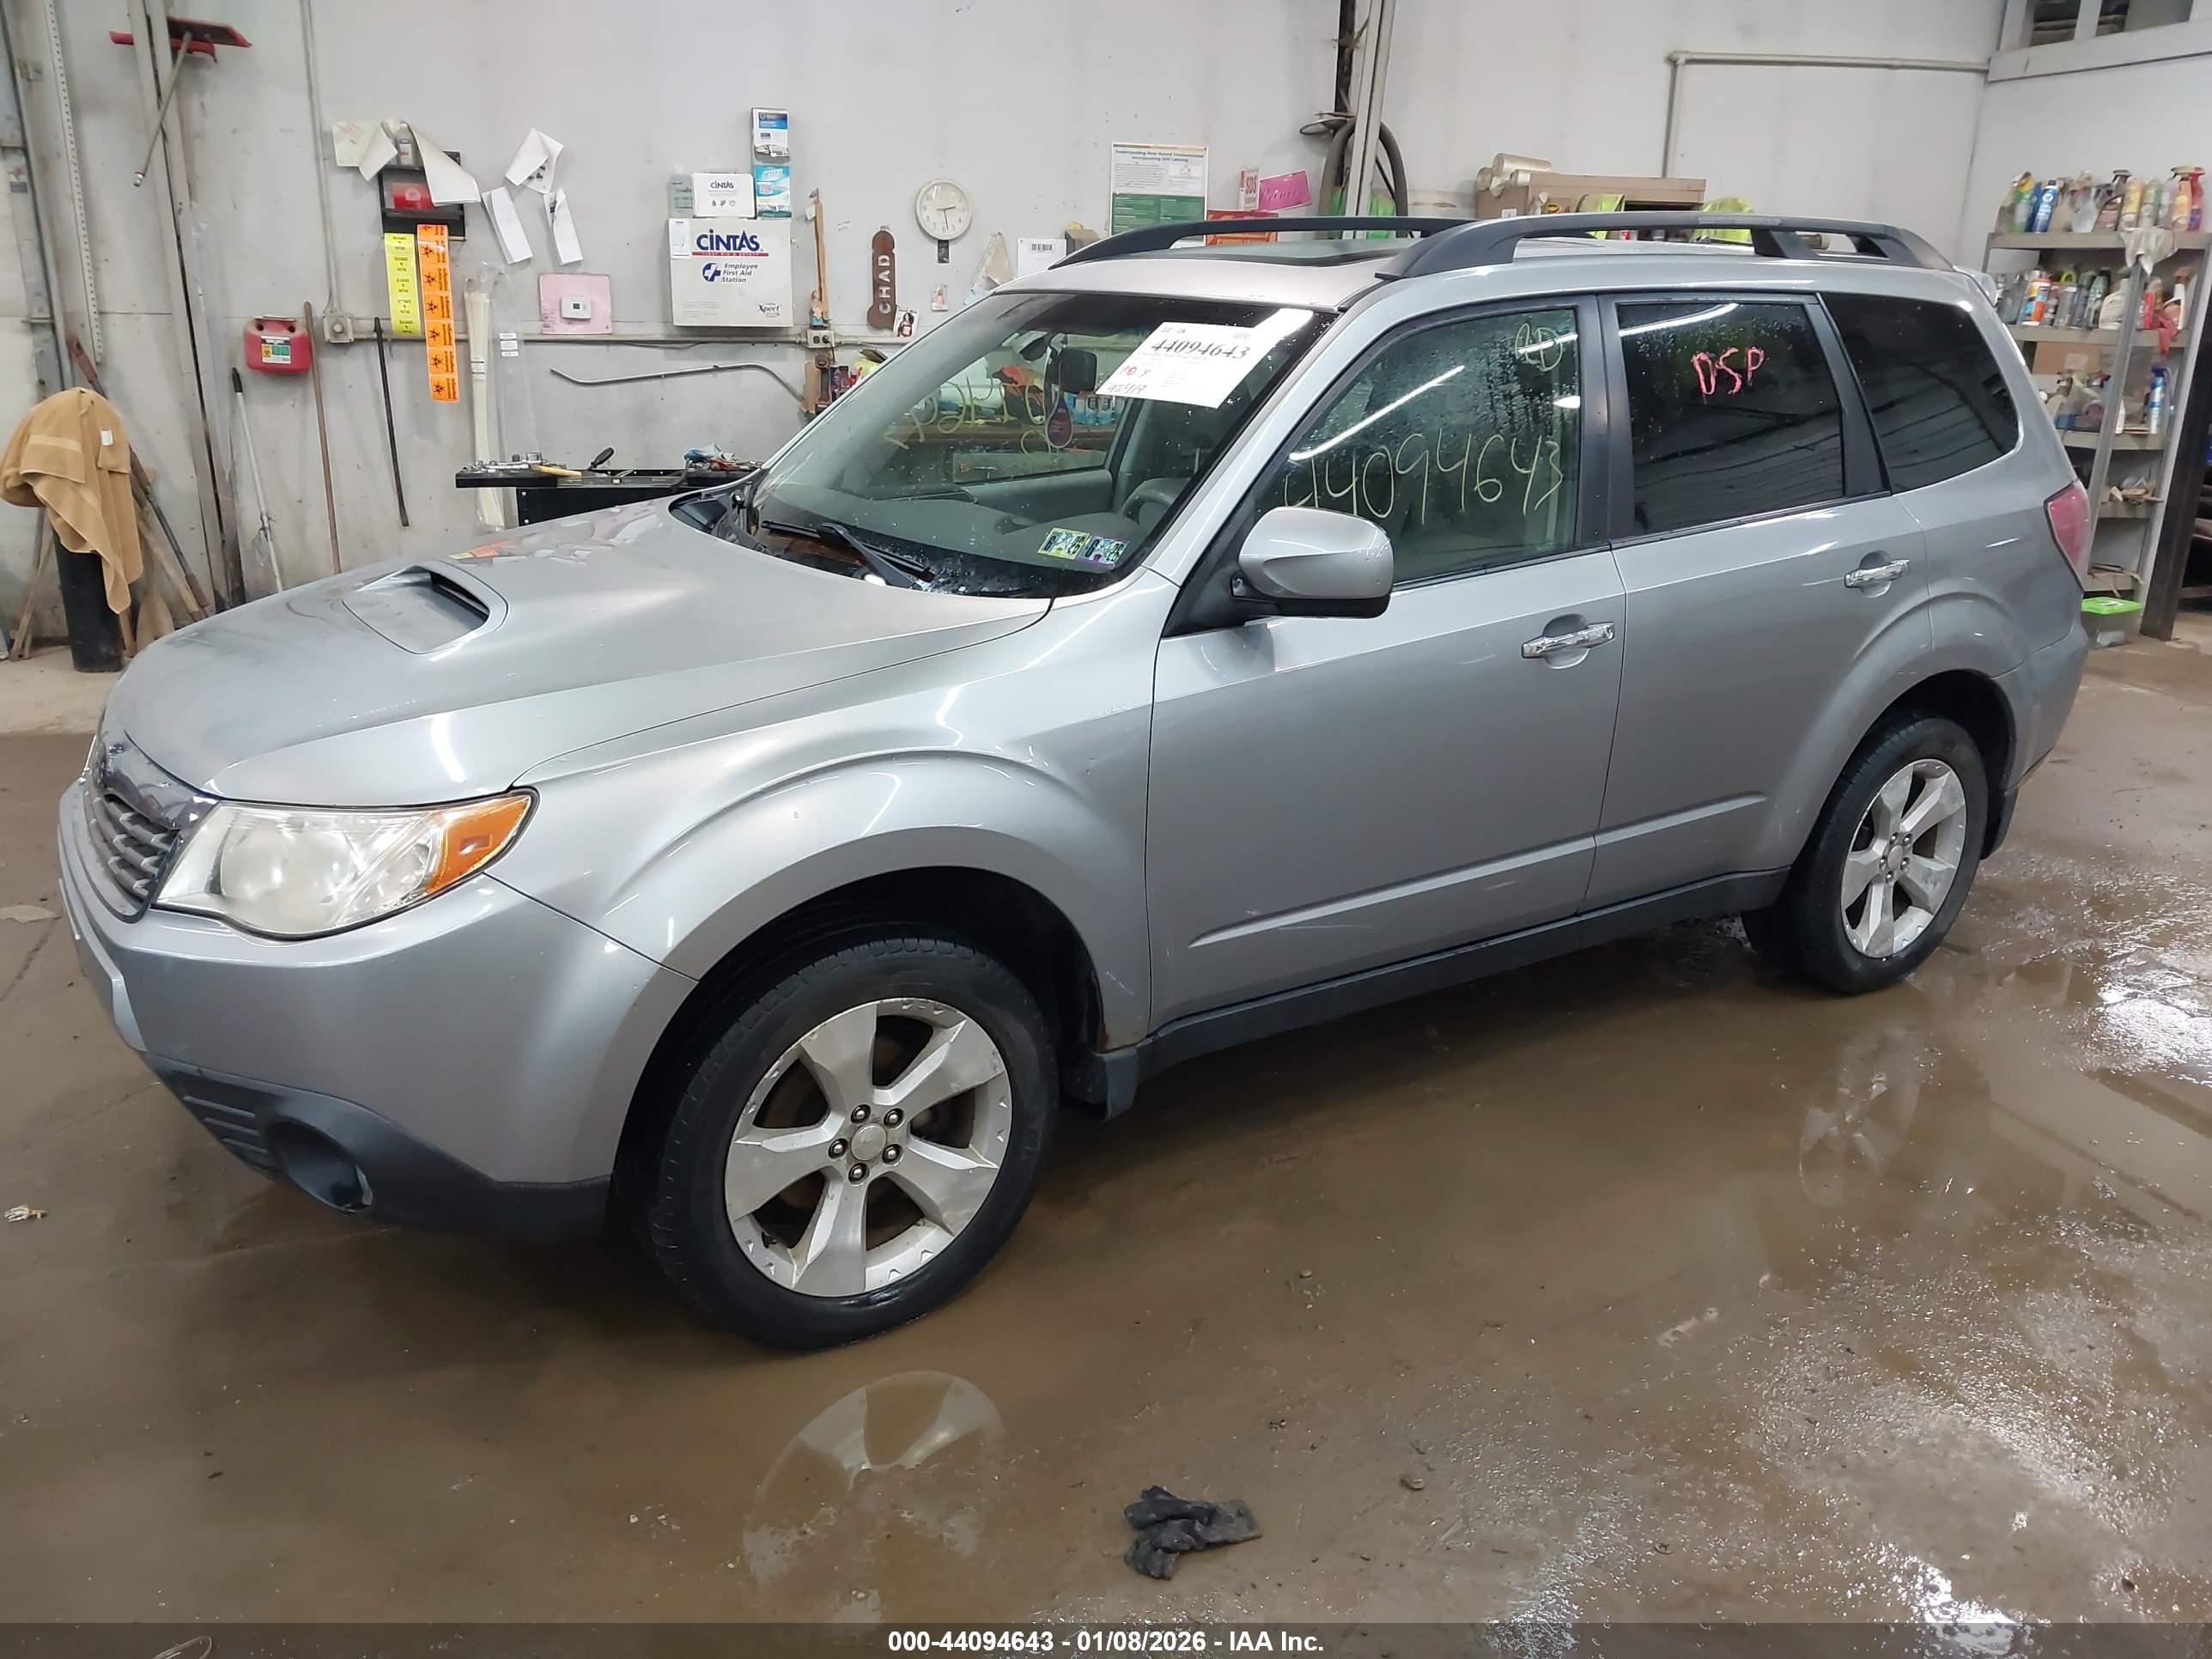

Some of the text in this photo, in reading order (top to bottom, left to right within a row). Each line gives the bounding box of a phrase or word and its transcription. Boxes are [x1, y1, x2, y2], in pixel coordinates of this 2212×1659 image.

[696, 228, 760, 252] CINTAS
[878, 254, 890, 314] CHAD
[1151, 338, 1251, 359] 44094643
[1285, 428, 1564, 526] 44094643
[1043, 535, 1056, 551] 6
[1085, 539, 1100, 557] 6
